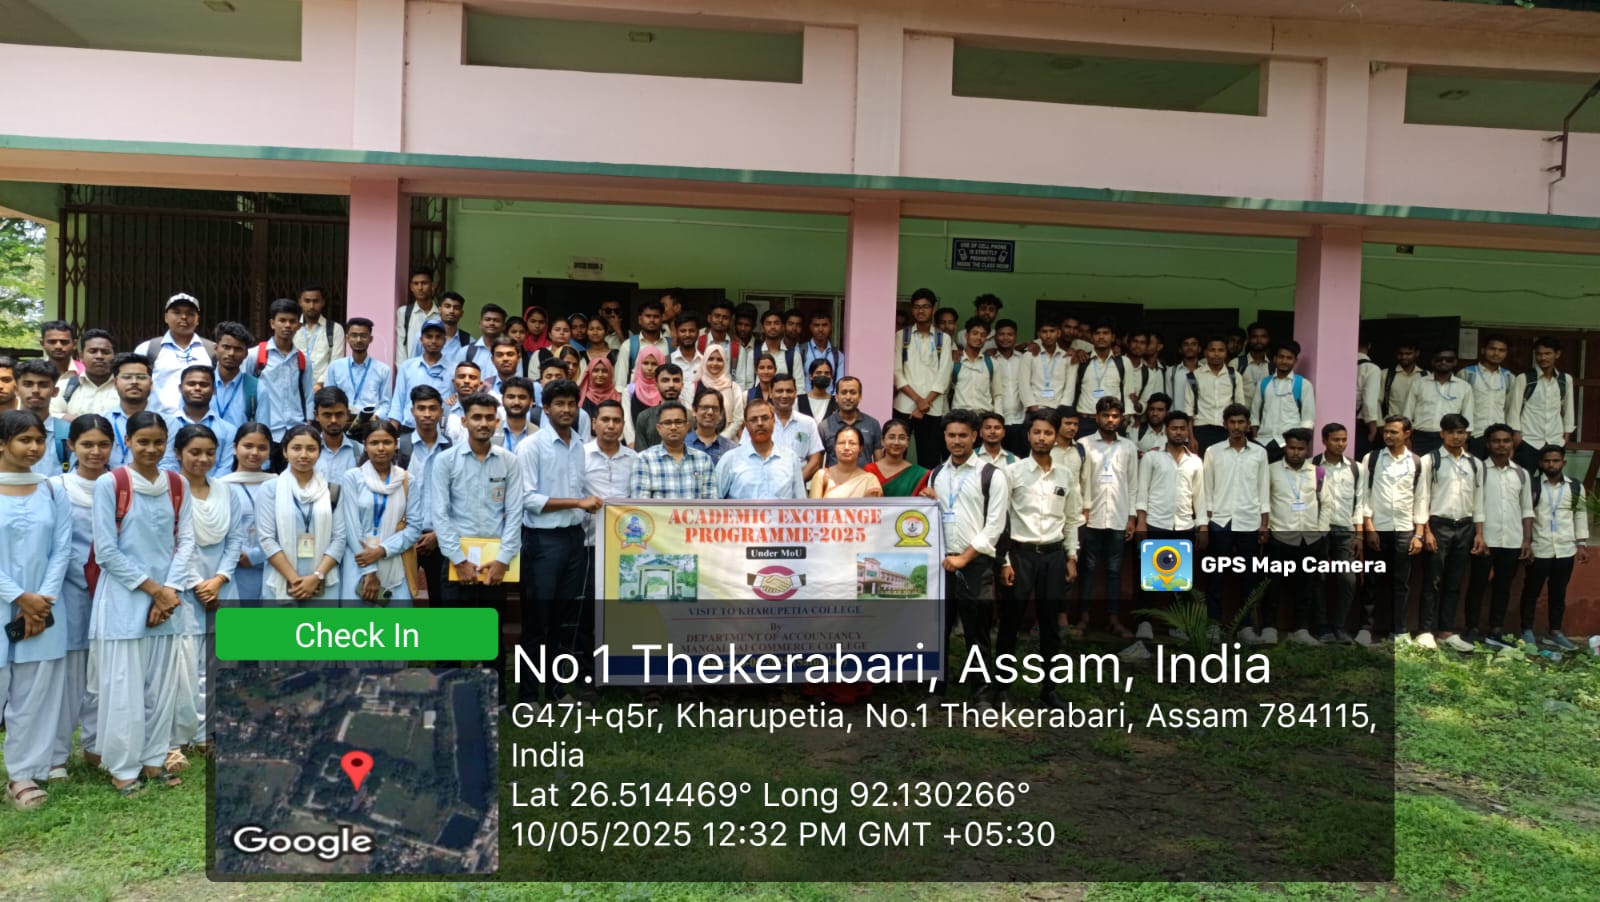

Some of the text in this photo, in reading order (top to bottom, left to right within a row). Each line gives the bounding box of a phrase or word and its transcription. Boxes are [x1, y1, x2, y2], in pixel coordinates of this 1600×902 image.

[668, 508, 882, 525] ACADEMIC EXCHANGE
[685, 527, 867, 544] PROGRAMME-2025
[751, 549, 802, 558] Under MoU
[688, 605, 863, 617] VISIT TO KHARUPETIA COLLEGE
[770, 622, 782, 632] By
[686, 631, 863, 643] DEPARTMENT OF ACCOUNTANCY
[680, 643, 747, 654] MANGALAI
